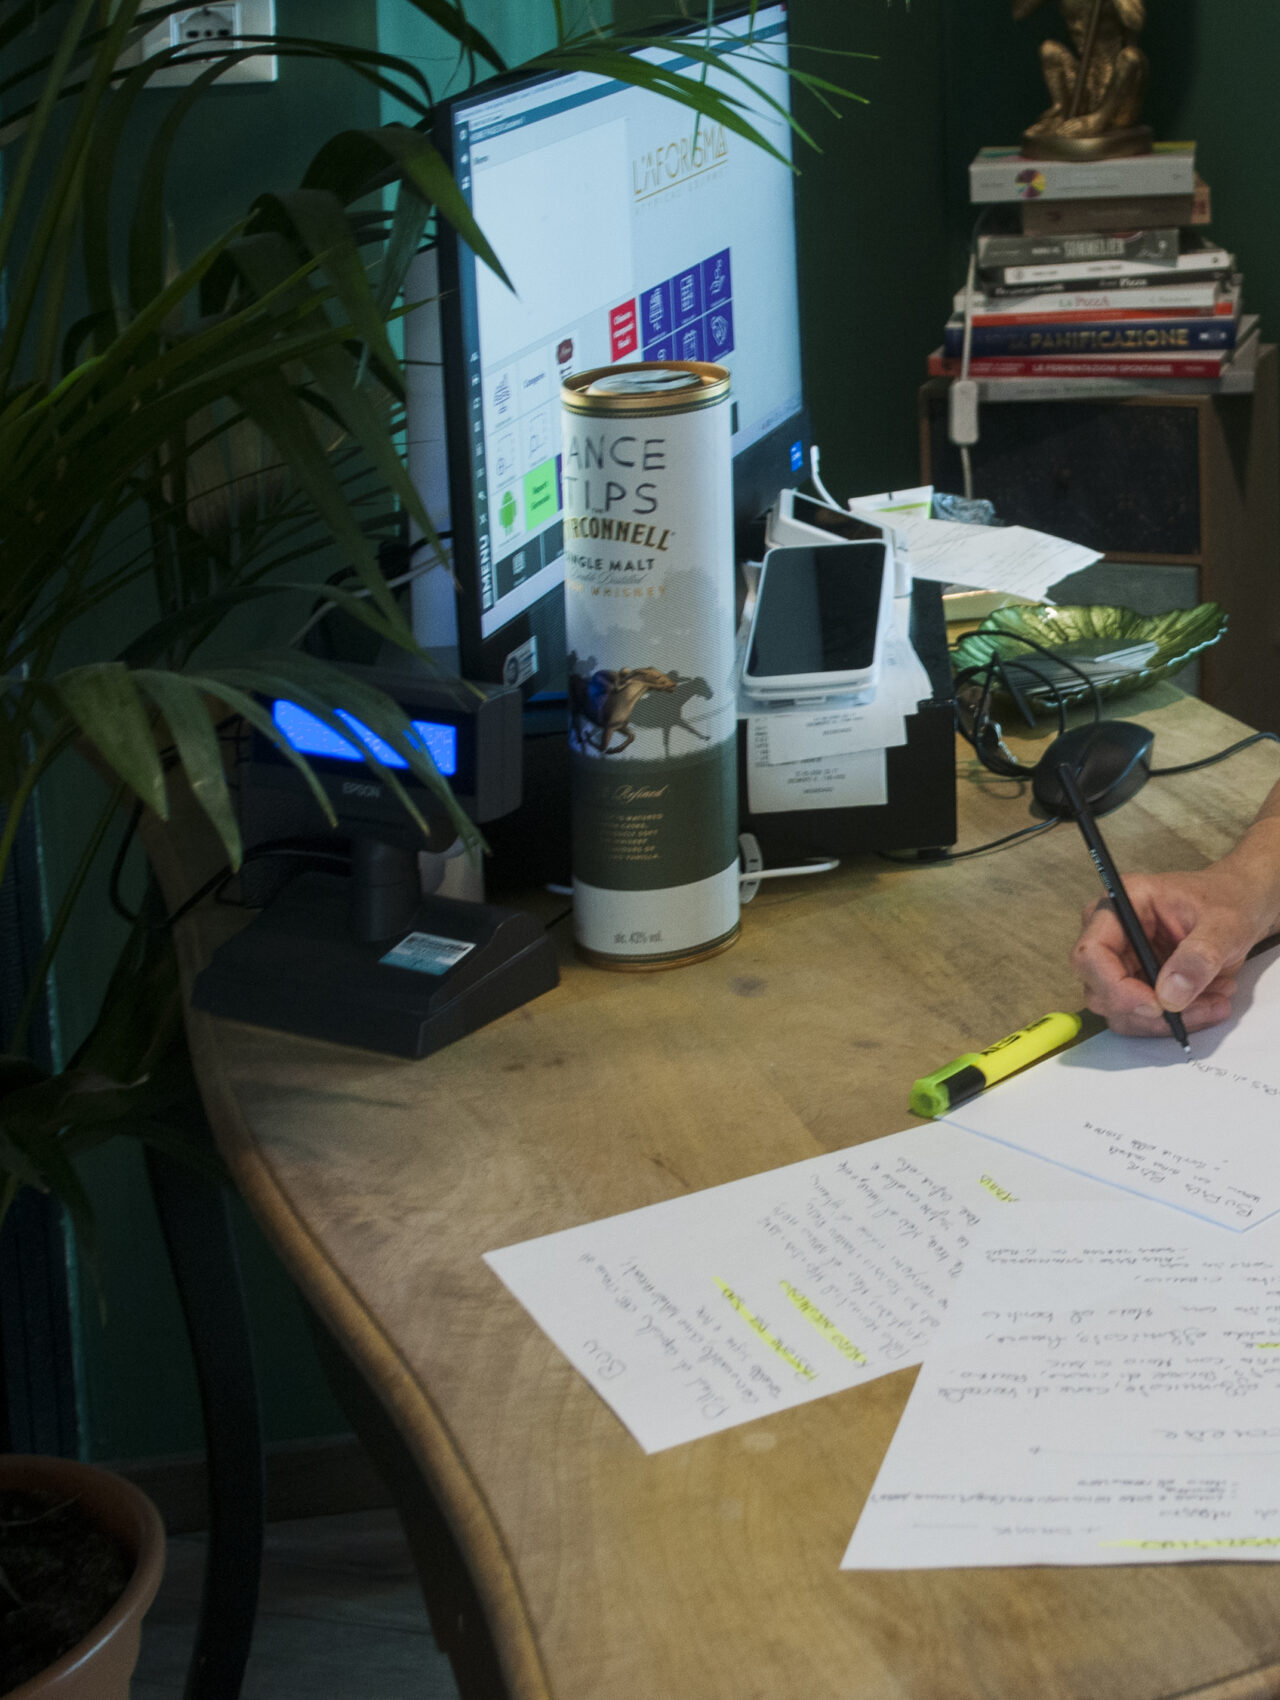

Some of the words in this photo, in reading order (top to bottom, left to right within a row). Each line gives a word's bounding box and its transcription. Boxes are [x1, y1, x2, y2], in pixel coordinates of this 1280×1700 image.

[1029, 327, 1190, 349] PANIFICAZIONE
[565, 476, 659, 515] TIPS
[608, 558, 656, 572] MALT
